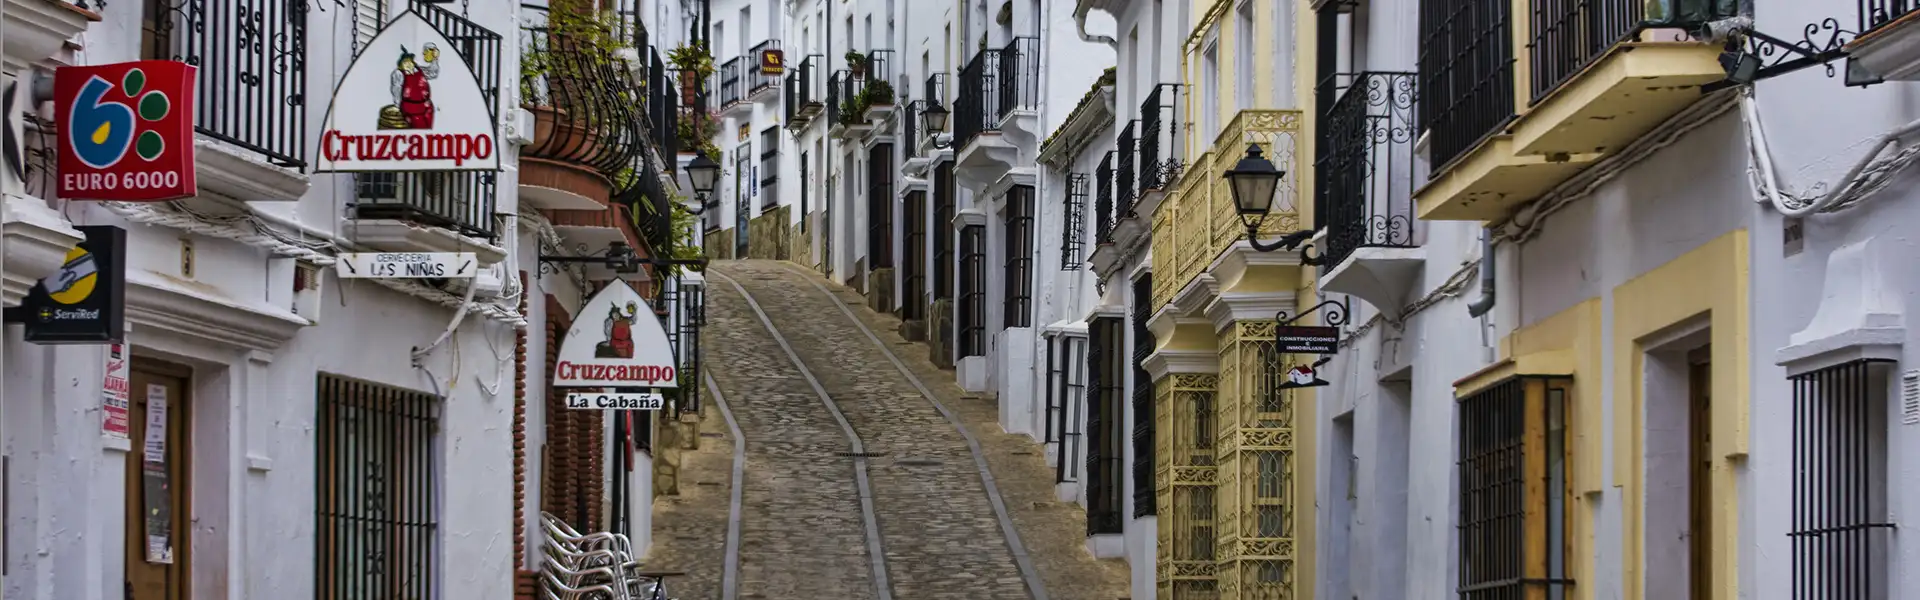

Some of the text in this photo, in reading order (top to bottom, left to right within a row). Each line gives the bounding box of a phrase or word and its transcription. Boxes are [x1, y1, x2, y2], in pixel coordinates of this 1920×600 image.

[69, 74, 136, 169] 6
[322, 129, 492, 166] Cruzcampo
[64, 170, 179, 191] EURO 6000
[376, 253, 432, 262] CERVECERIA
[370, 262, 445, 276] LAS NIÑAS
[55, 308, 100, 320] ServiRed
[558, 361, 674, 385] Cruzcampo
[568, 395, 660, 409] La Cabaña
